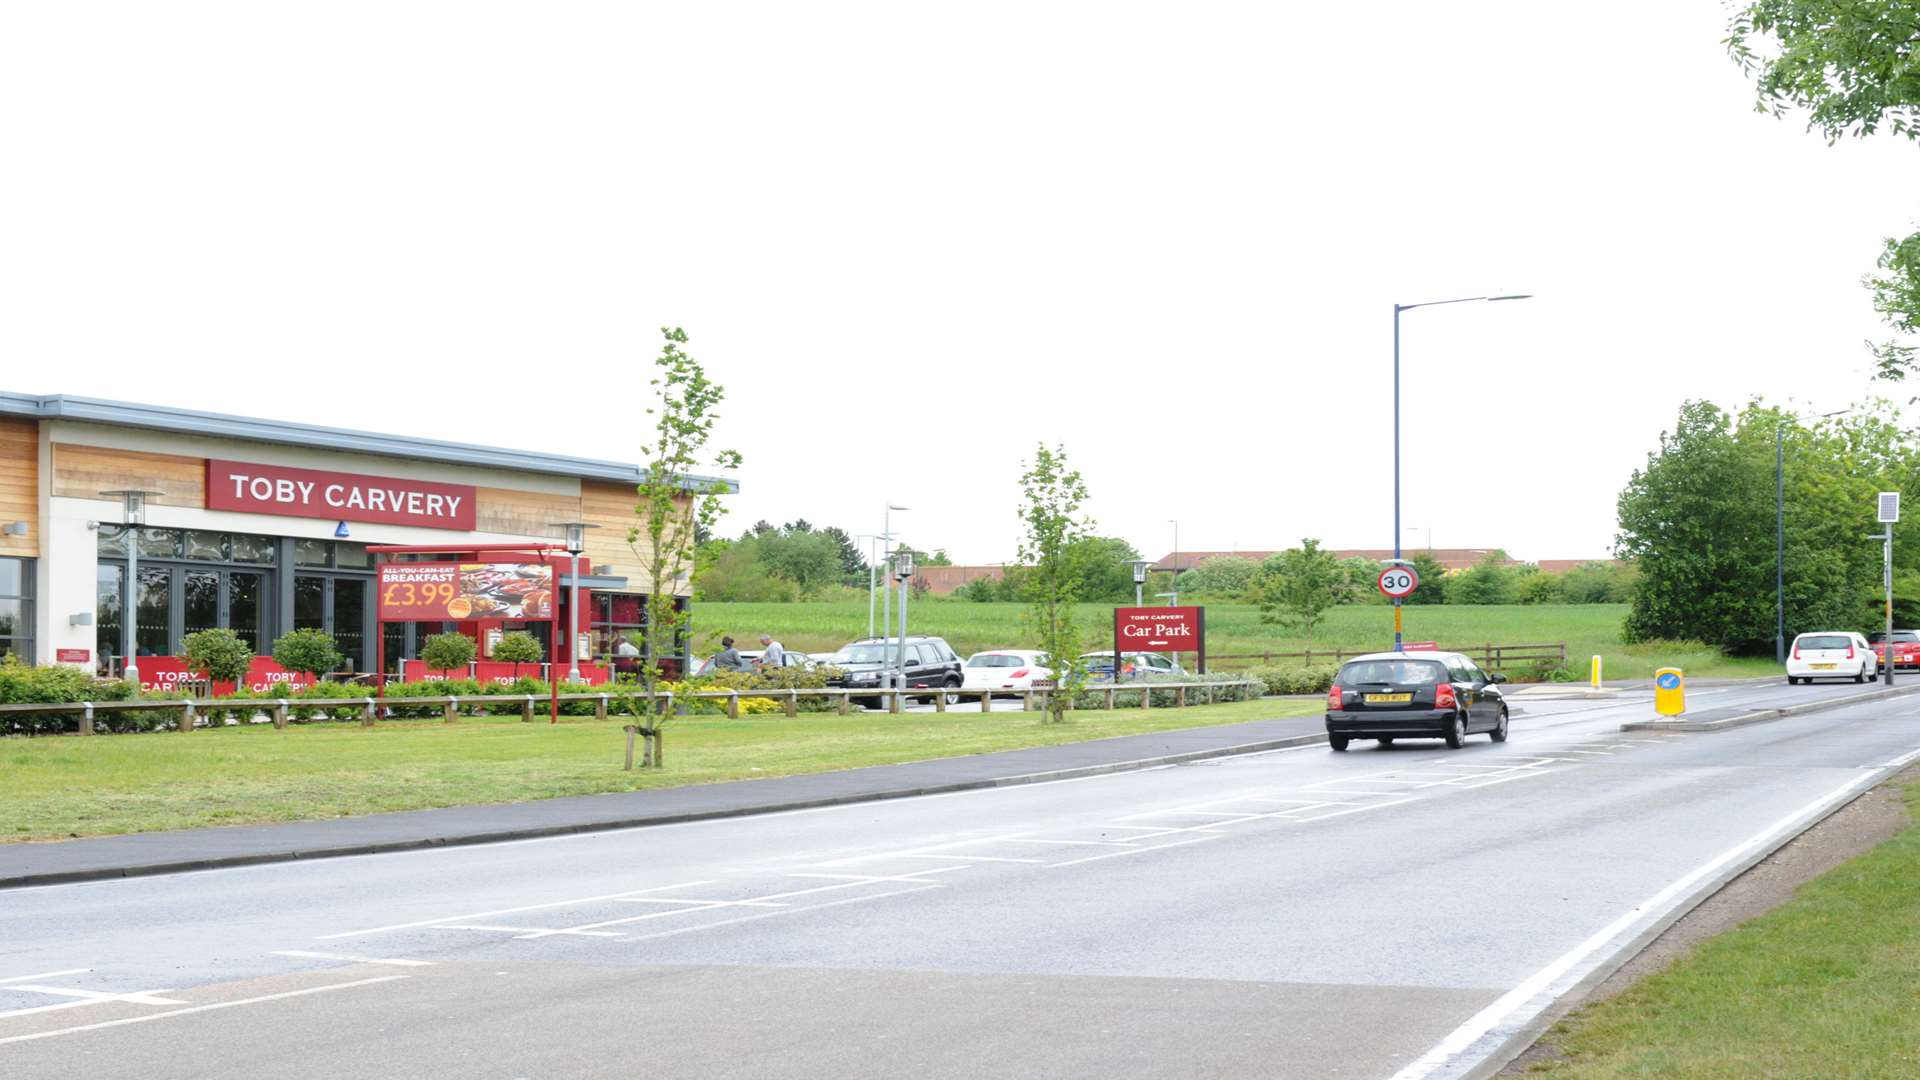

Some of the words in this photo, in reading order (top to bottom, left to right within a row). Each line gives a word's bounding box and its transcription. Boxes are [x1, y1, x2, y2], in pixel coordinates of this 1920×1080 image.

[229, 474, 316, 505] TOBY
[324, 484, 462, 518] CARVERY
[382, 573, 456, 583] BREAKFAST
[1383, 575, 1410, 589] 30
[383, 583, 456, 606] £3.99
[1123, 624, 1152, 637] Car
[1155, 623, 1191, 637] Park
[156, 671, 200, 682] TOBY
[265, 672, 297, 683] TOBY
[564, 677, 592, 687] TBY
